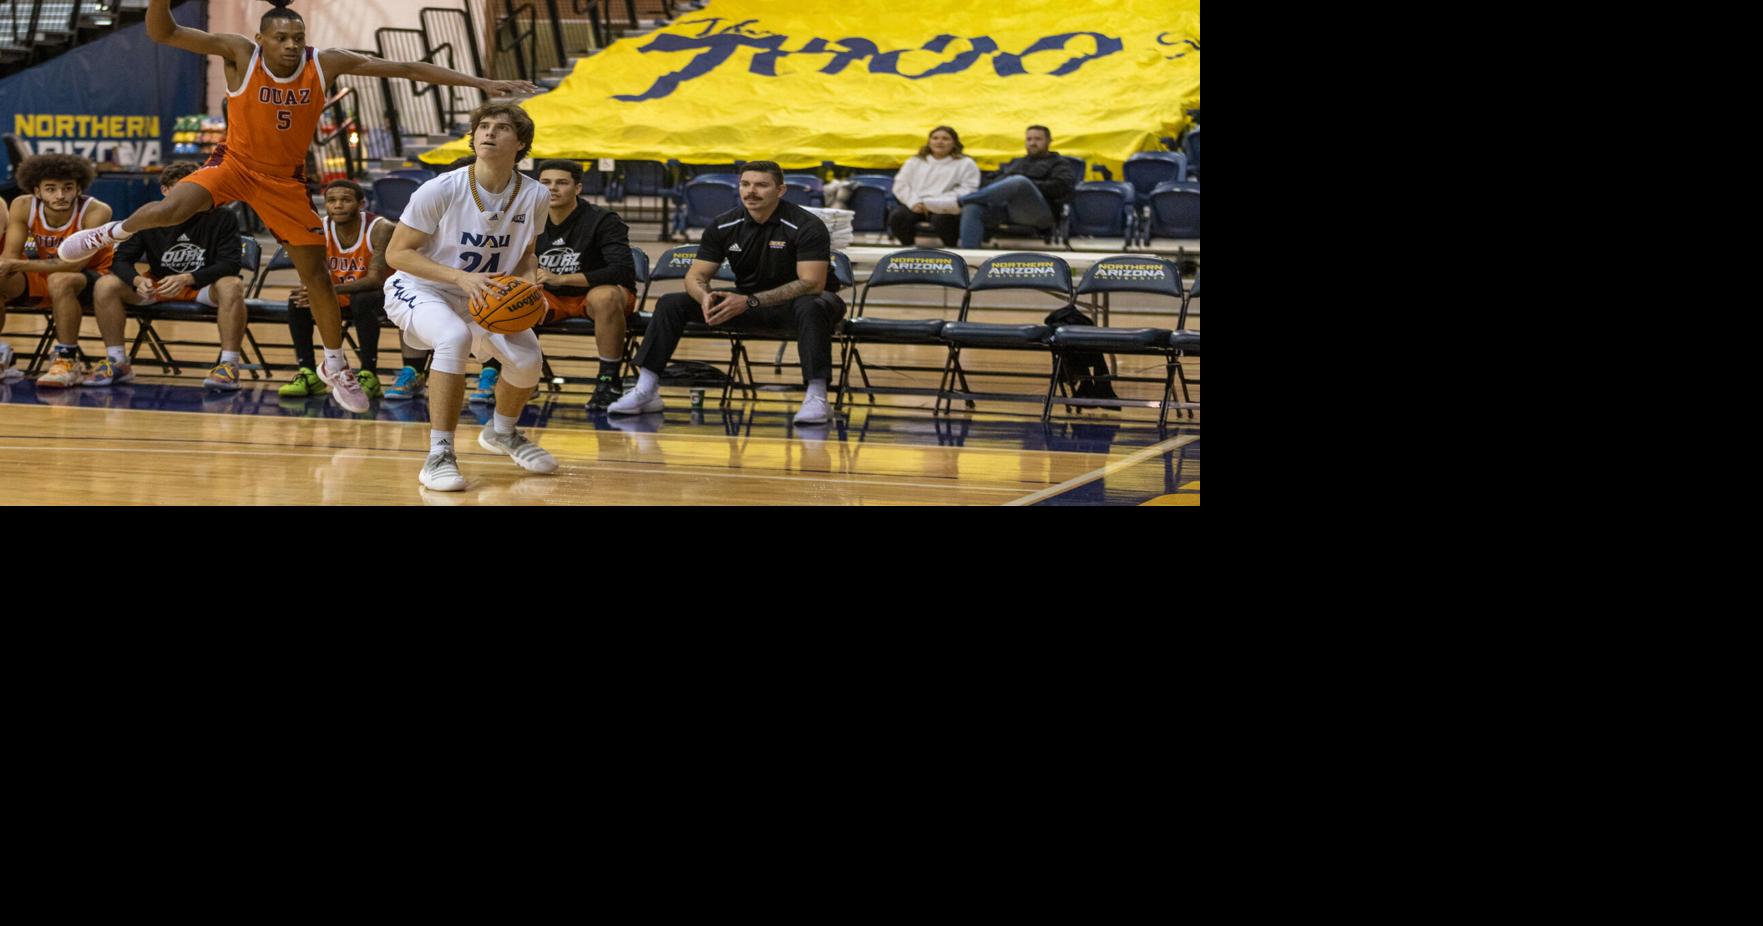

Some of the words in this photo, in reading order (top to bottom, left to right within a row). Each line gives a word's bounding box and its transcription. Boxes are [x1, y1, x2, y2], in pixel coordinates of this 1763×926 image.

[259, 86, 311, 106] OUAZ
[14, 114, 160, 138] NORTHERN
[276, 109, 293, 132] 5
[460, 231, 511, 249] NAU
[161, 249, 206, 263] OUAZ
[459, 251, 500, 273] 24
[538, 252, 581, 268] OUAZ
[887, 262, 954, 270] ARIZONA
